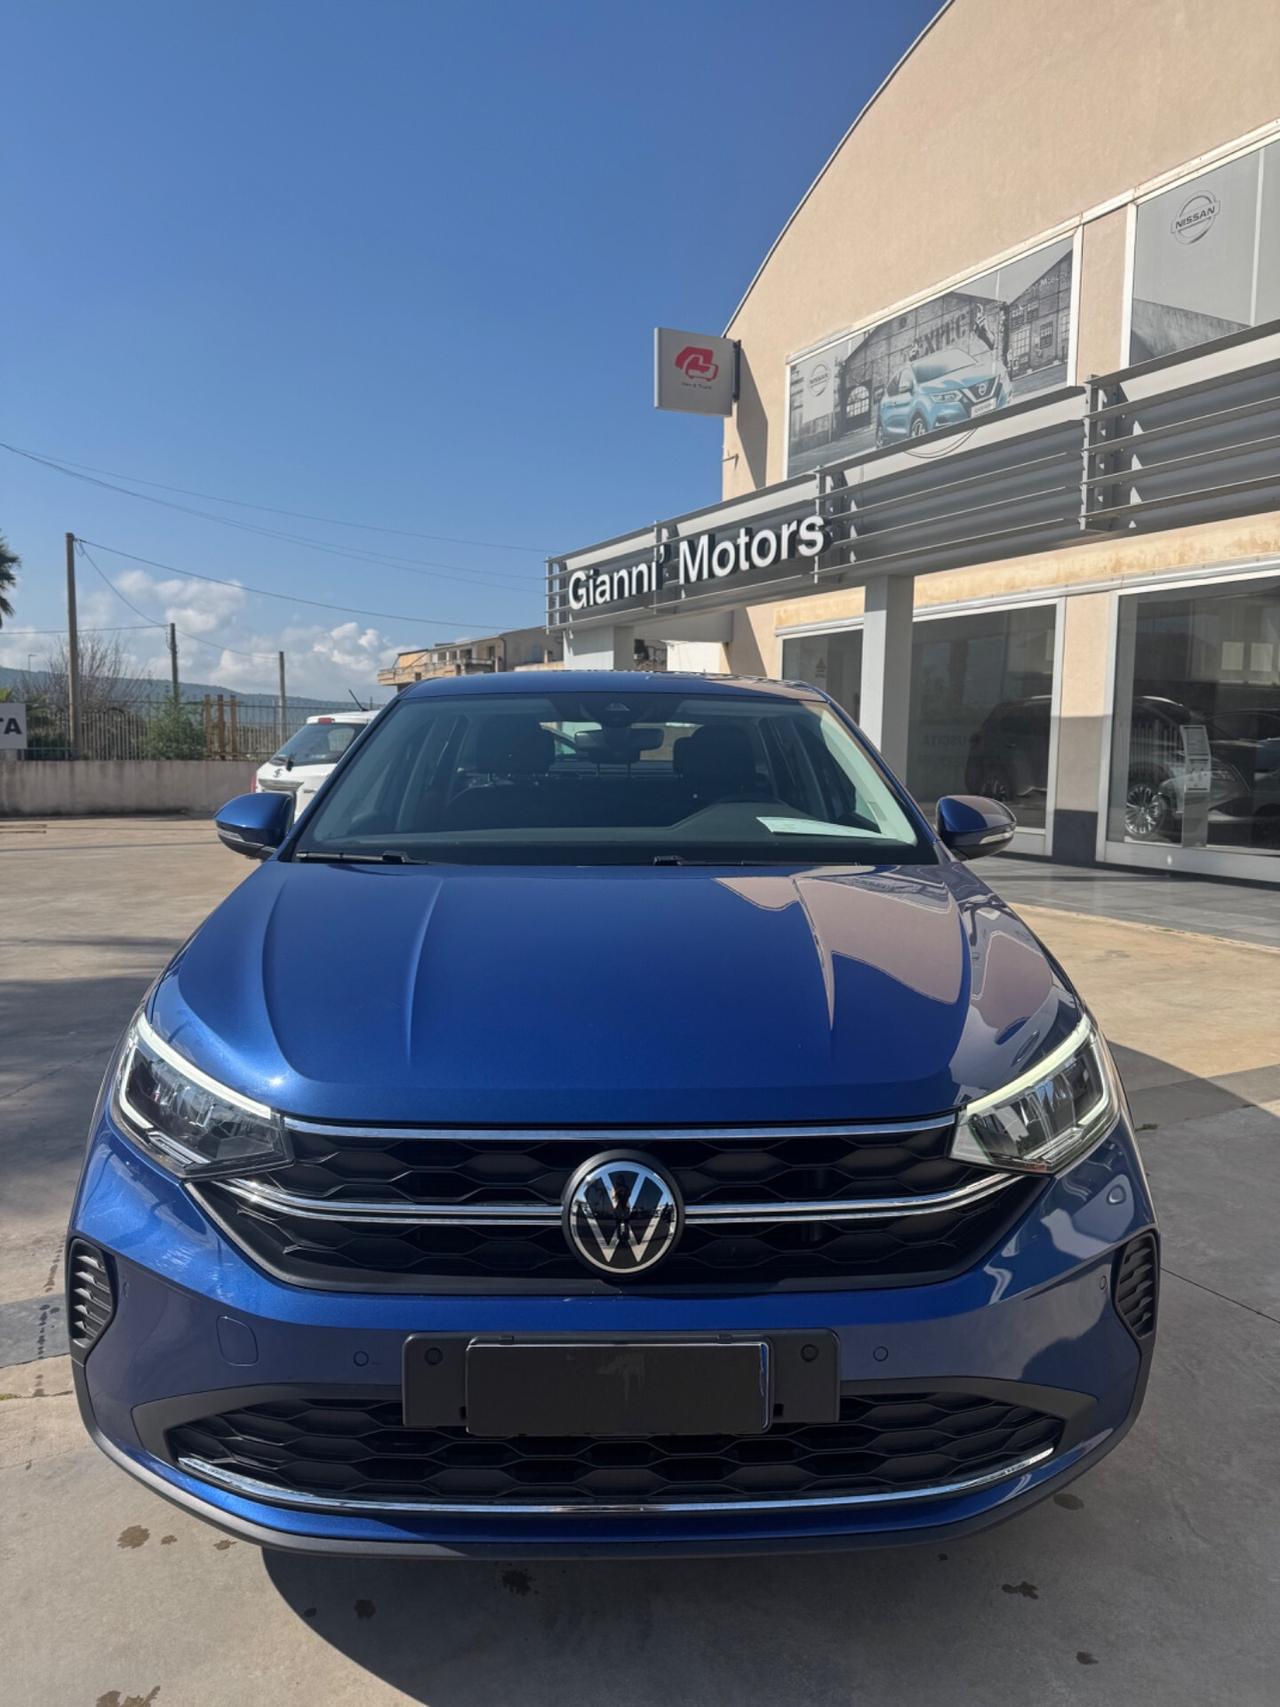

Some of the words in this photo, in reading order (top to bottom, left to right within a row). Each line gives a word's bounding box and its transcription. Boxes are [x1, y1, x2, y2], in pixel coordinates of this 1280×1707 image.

[1176, 205, 1215, 229] NISSAN
[678, 514, 825, 586] Motors
[0, 718, 22, 735] A
